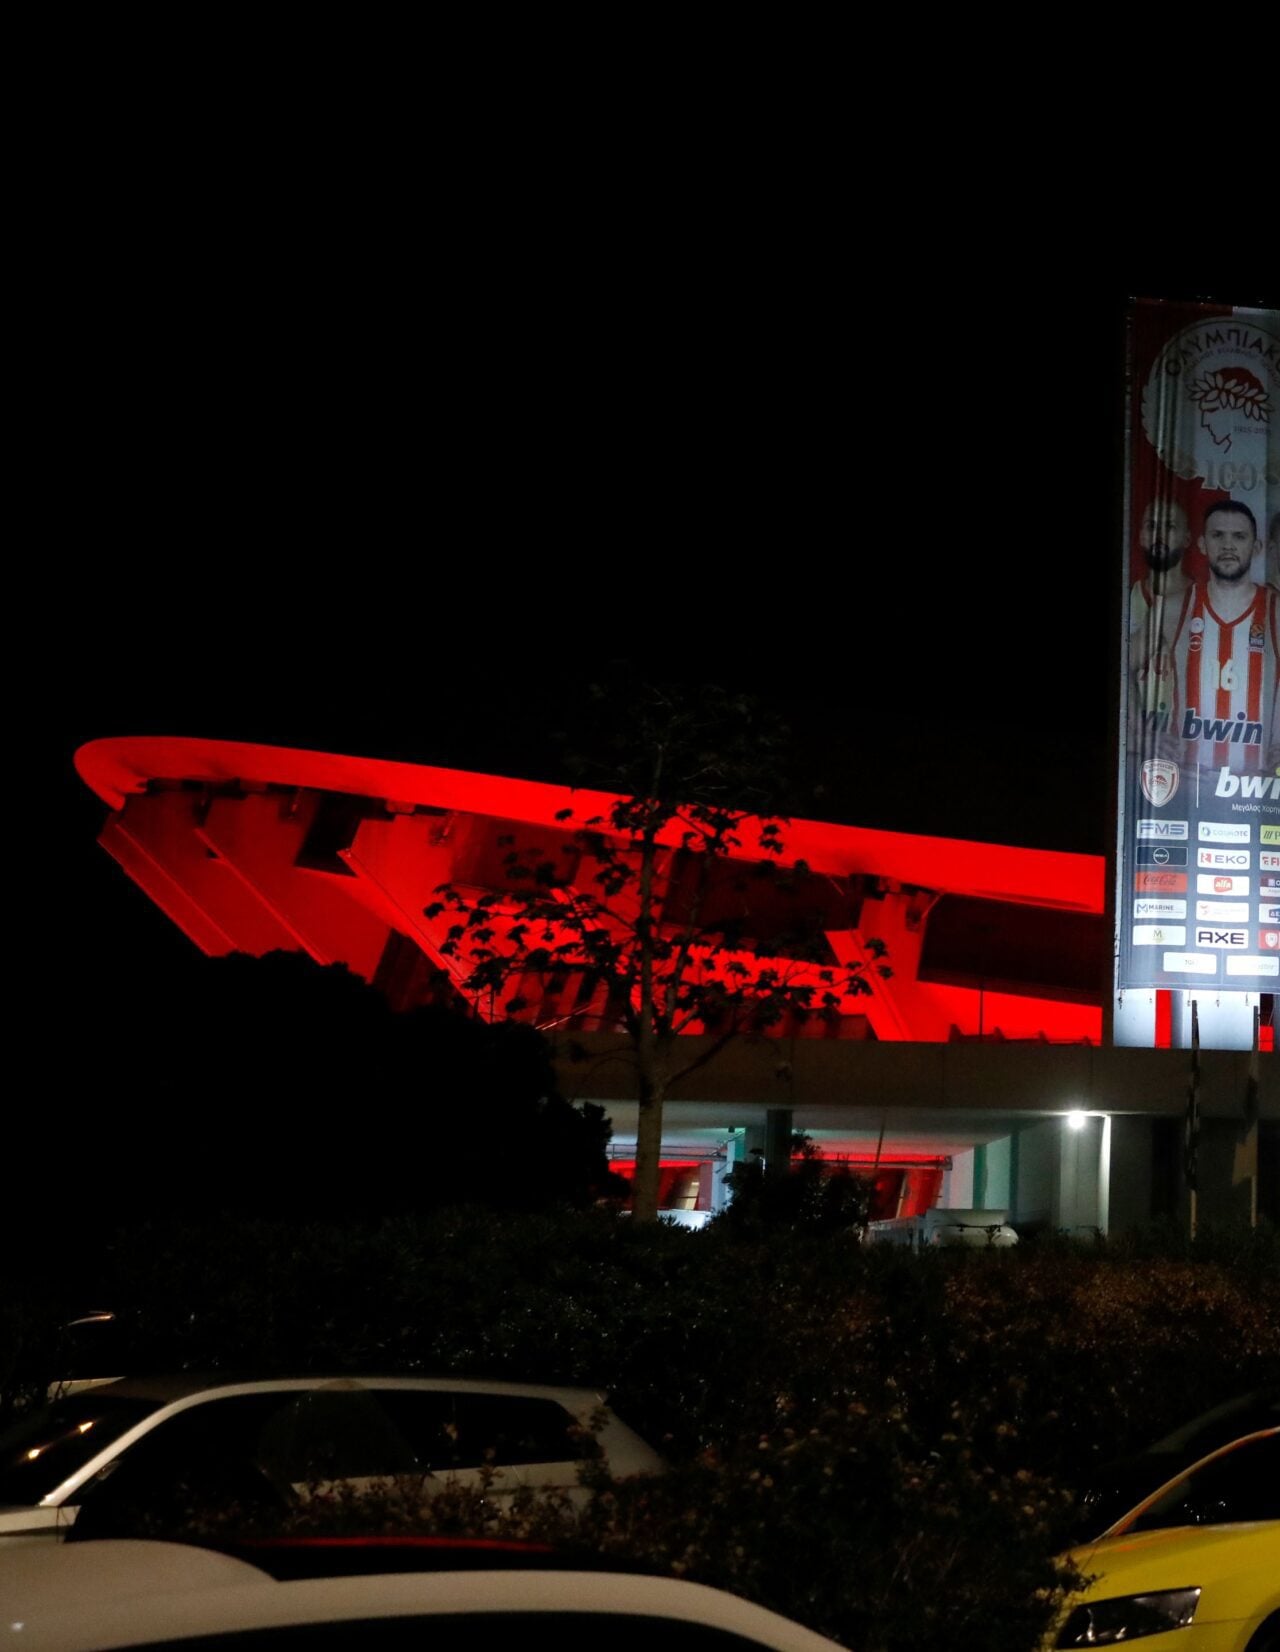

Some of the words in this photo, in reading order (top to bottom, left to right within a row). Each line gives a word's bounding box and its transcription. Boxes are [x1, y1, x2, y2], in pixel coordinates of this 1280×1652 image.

[1182, 708, 1264, 744] bwin
[1231, 803, 1261, 814] Μεγάλος
[1139, 823, 1186, 836] FMS
[1214, 854, 1248, 865] EKO
[1215, 880, 1232, 889] alfa
[1148, 904, 1175, 912] MARINE
[1198, 931, 1246, 945] AXE
